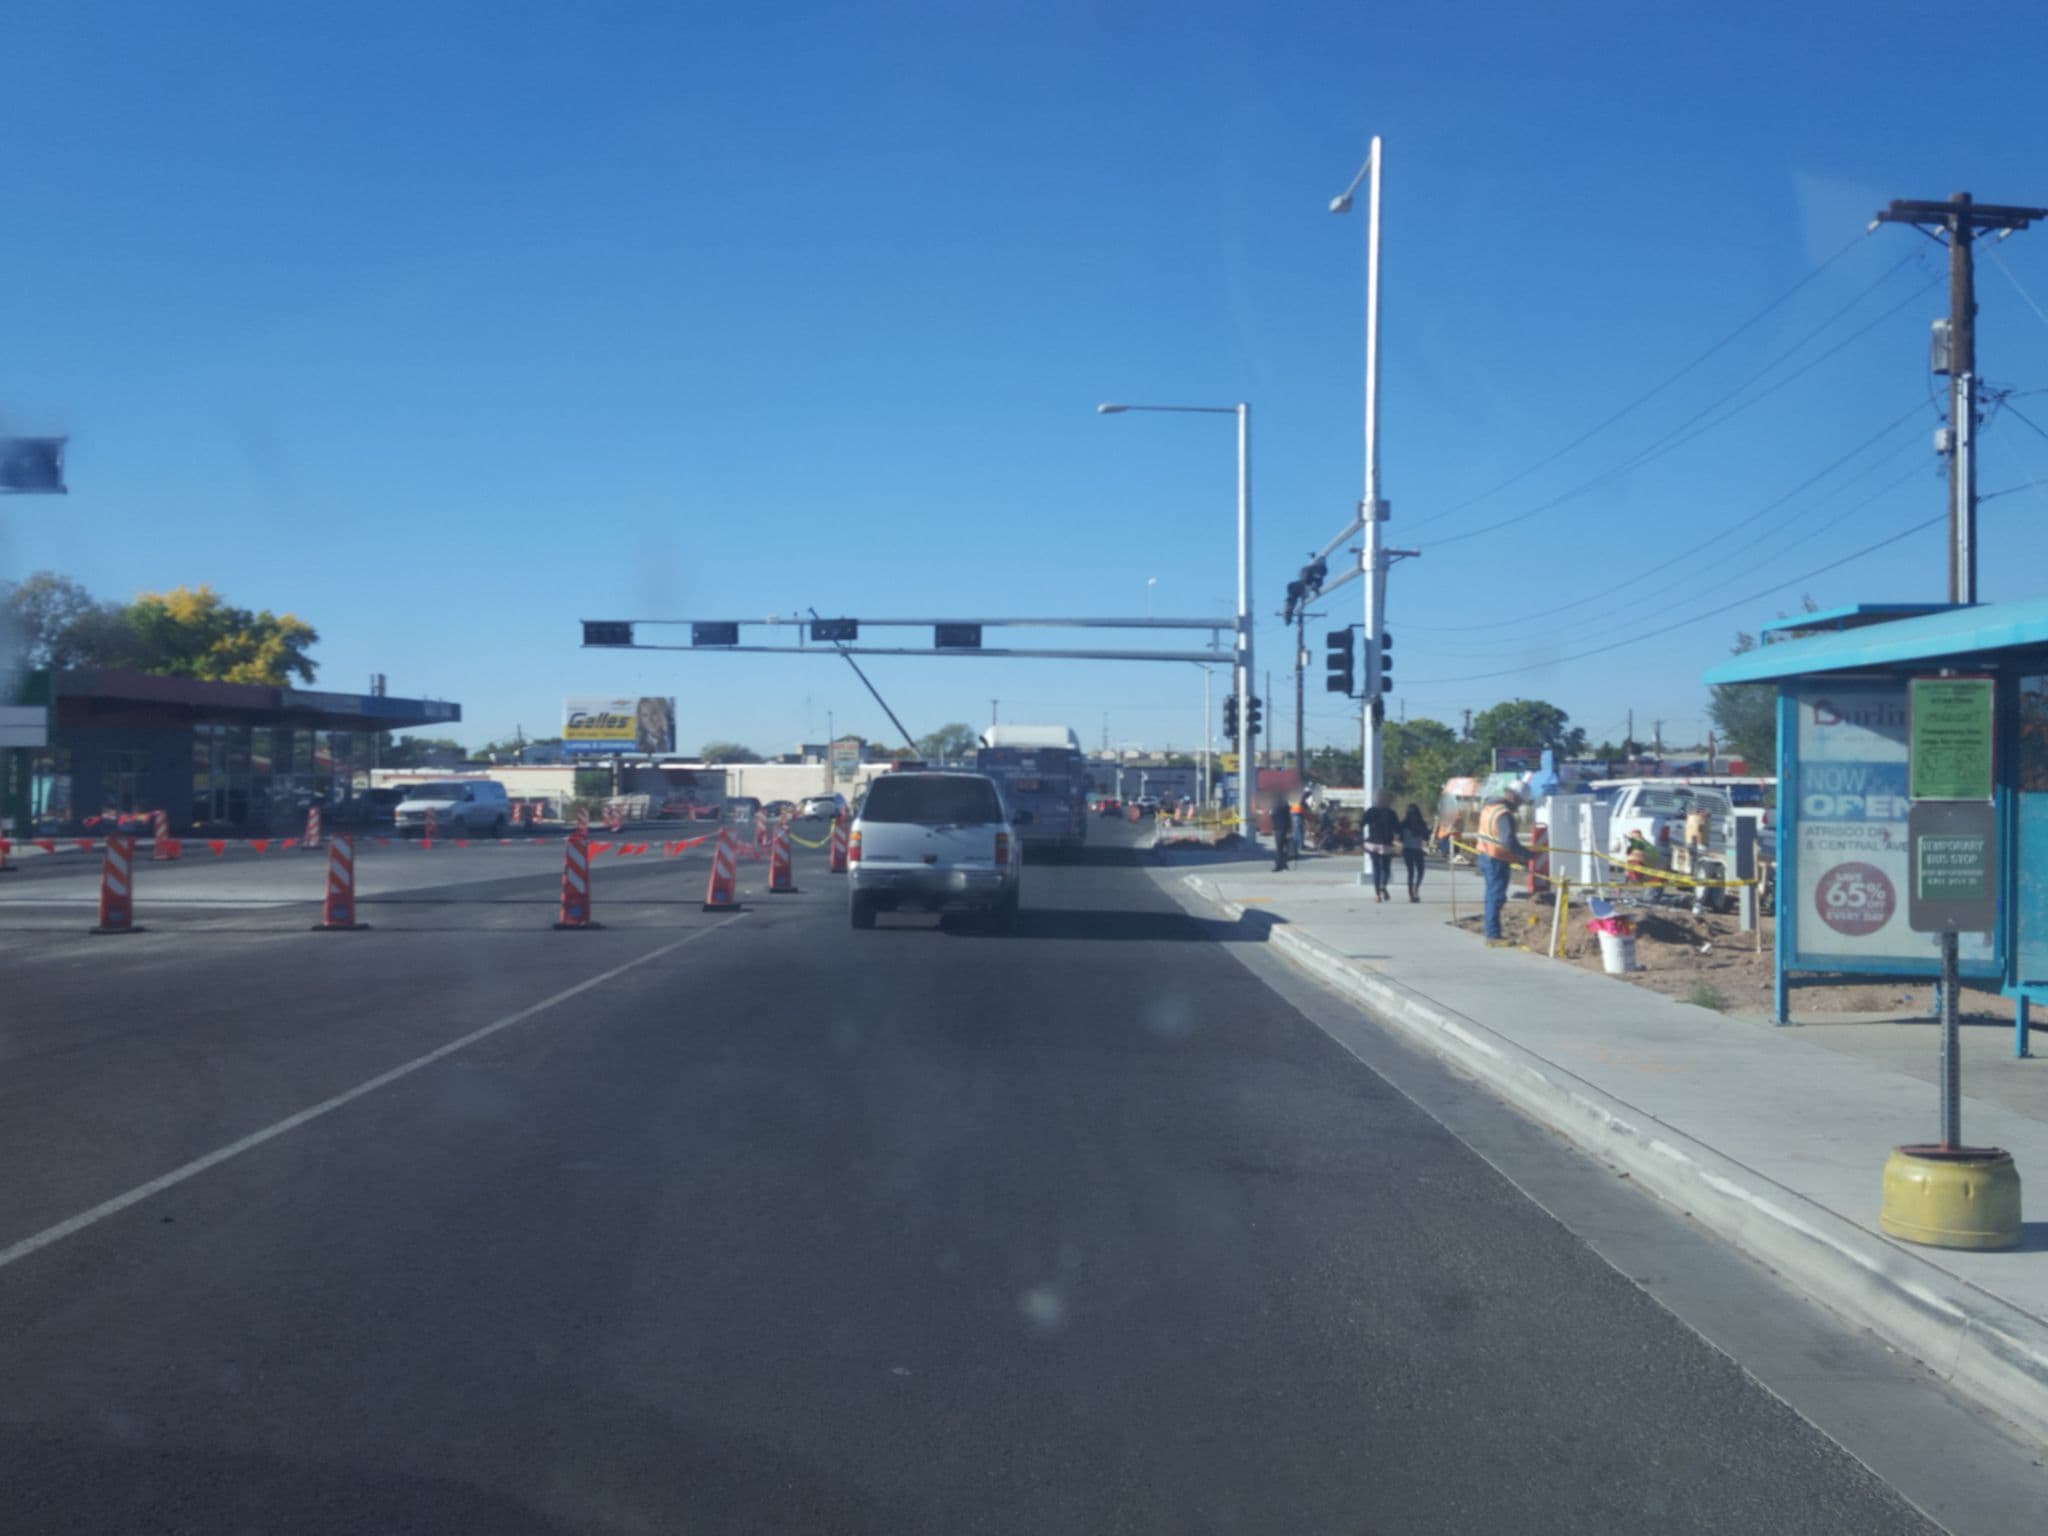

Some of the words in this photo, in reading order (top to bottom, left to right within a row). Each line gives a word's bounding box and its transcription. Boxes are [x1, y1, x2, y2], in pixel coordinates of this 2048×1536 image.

[568, 711, 629, 729] Galles
[1806, 767, 1868, 792] NOW
[1817, 840, 1877, 851] CENTRAL
